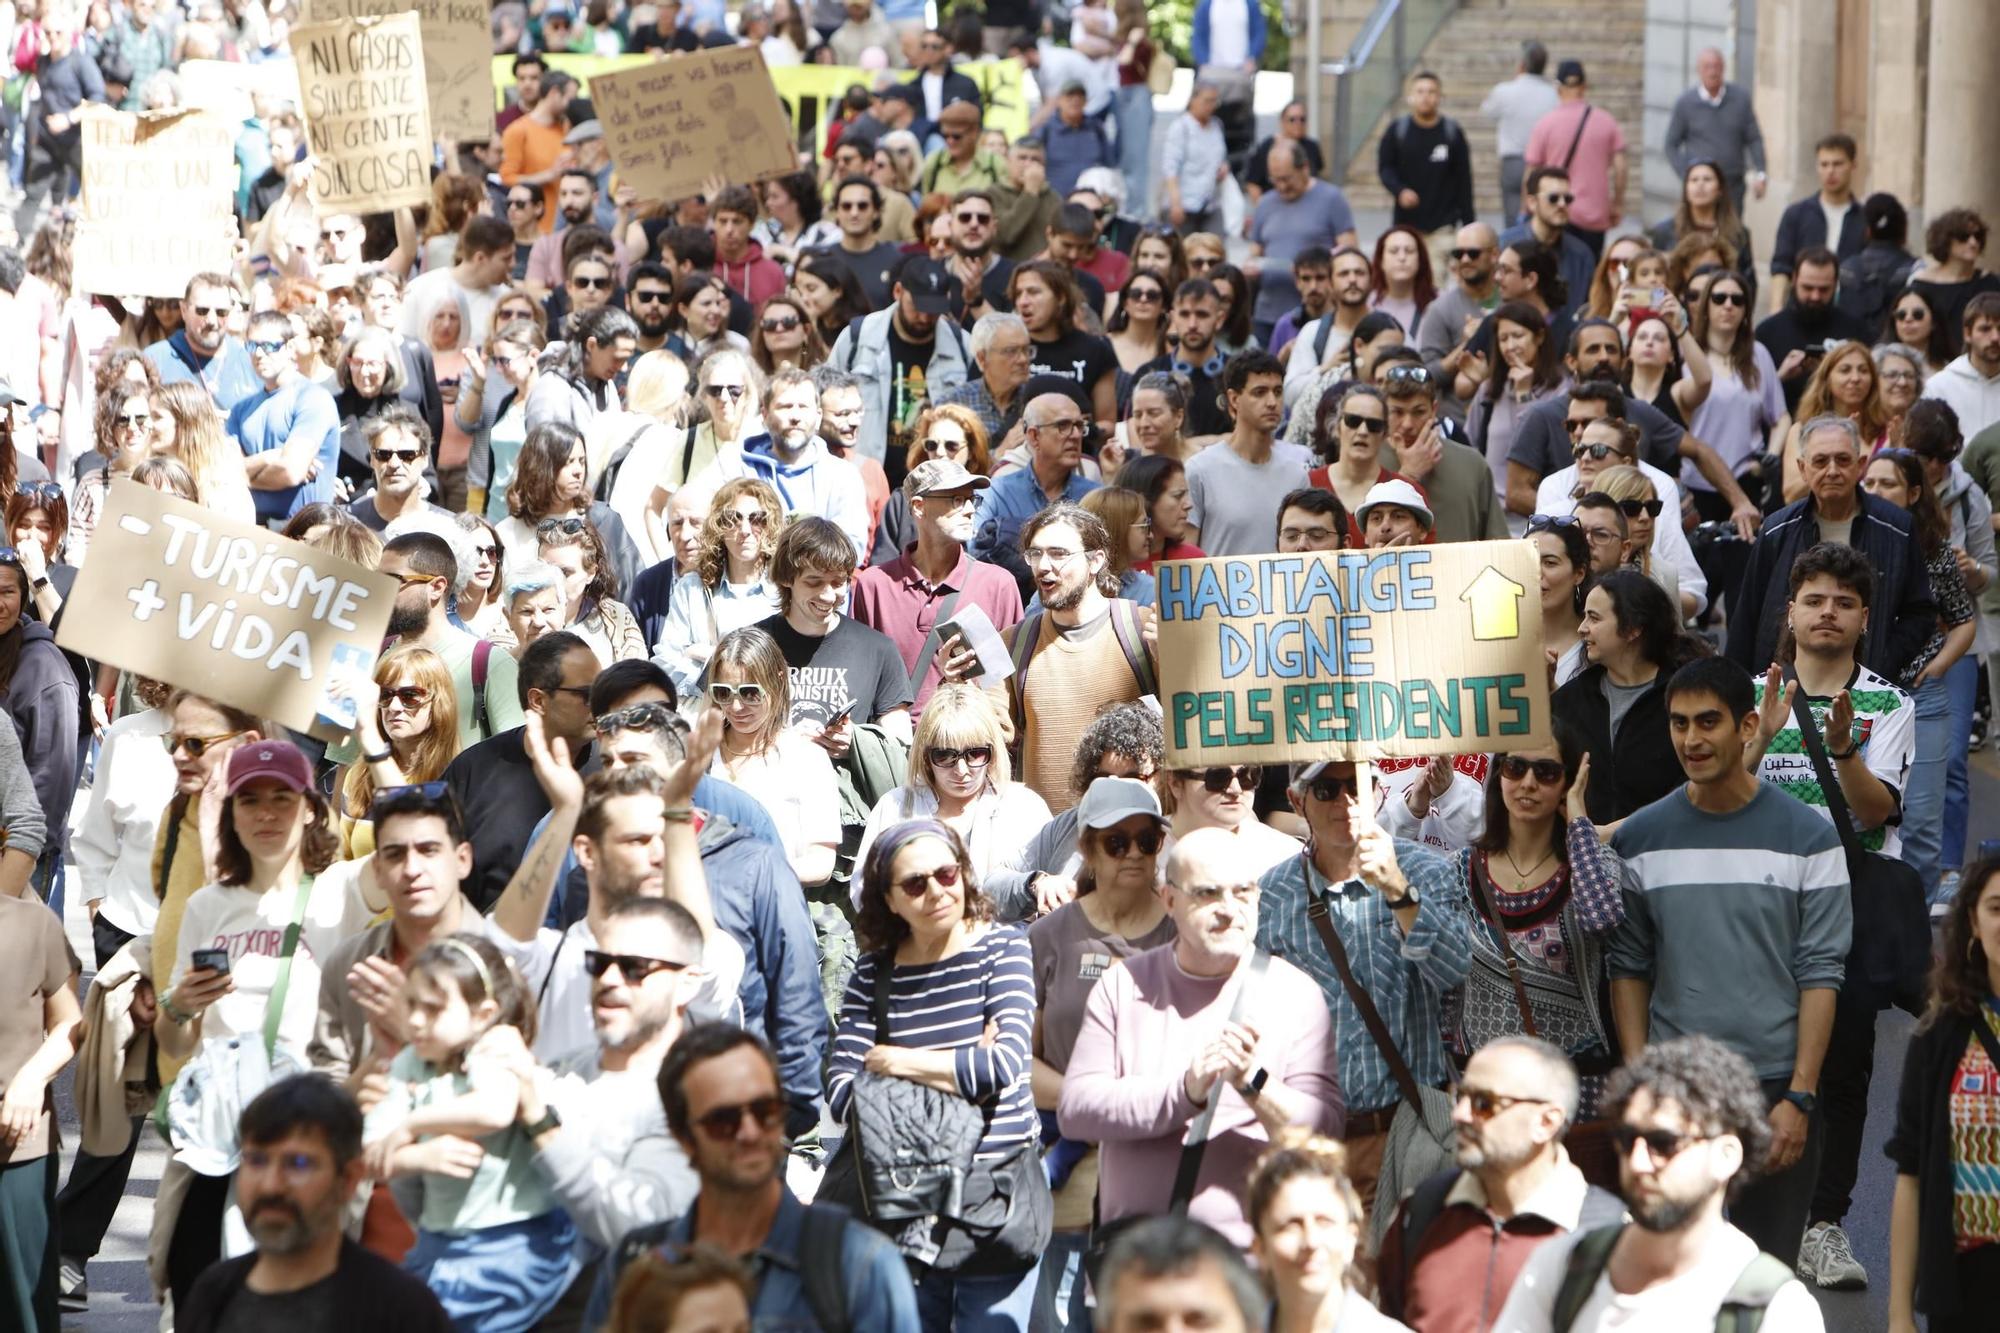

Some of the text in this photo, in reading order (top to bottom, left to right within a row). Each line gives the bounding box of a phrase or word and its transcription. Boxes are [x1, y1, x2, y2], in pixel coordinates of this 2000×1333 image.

[311, 31, 413, 75] NI CASAS
[310, 76, 414, 120] SIN GENTE
[312, 112, 418, 152] NI GENTE
[174, 160, 211, 190] UN
[317, 148, 424, 197] SIN CASA
[1159, 551, 1436, 621] HABITATGE
[1219, 616, 1374, 679] DIGNE
[1172, 673, 1531, 750] PELS RESIDENTS
